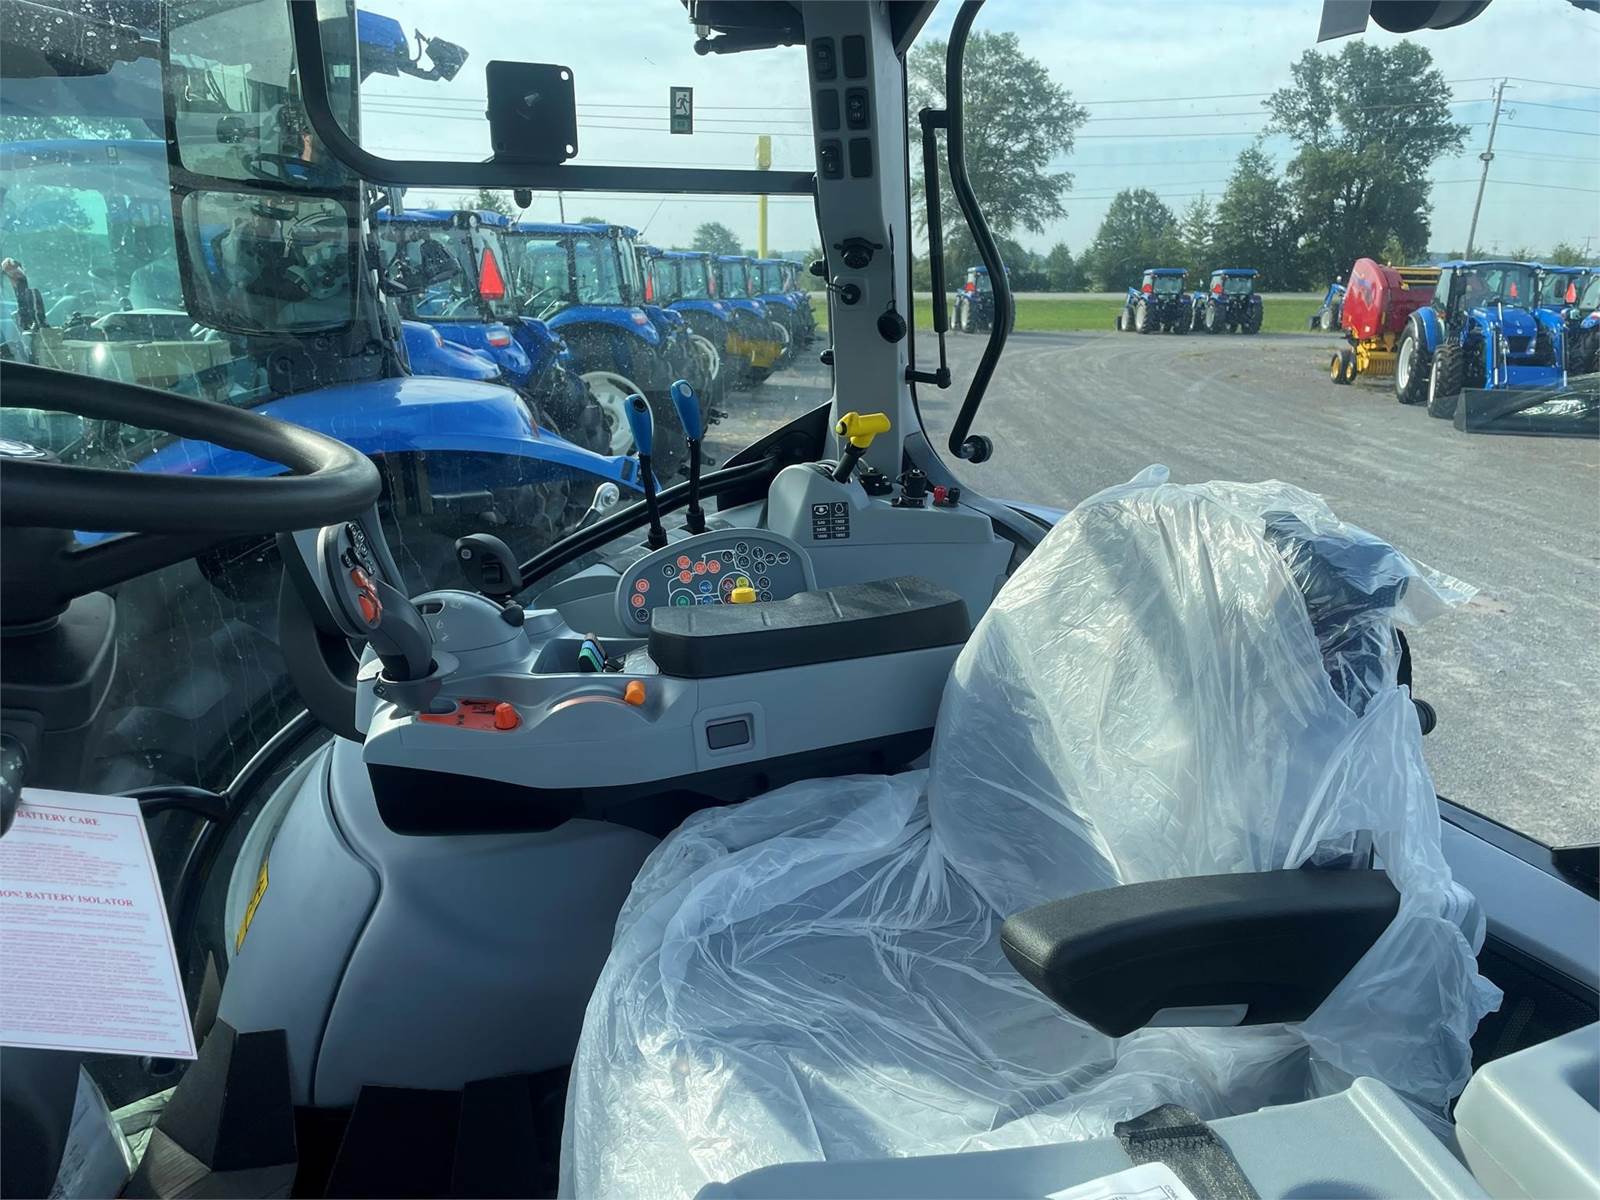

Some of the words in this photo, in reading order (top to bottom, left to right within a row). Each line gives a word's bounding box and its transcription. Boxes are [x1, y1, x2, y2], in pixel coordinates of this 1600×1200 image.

[16, 810, 65, 822] BATTERY
[69, 816, 101, 826] CARE
[25, 891, 76, 902] BATTERY
[79, 896, 134, 907] ISOLATOR
